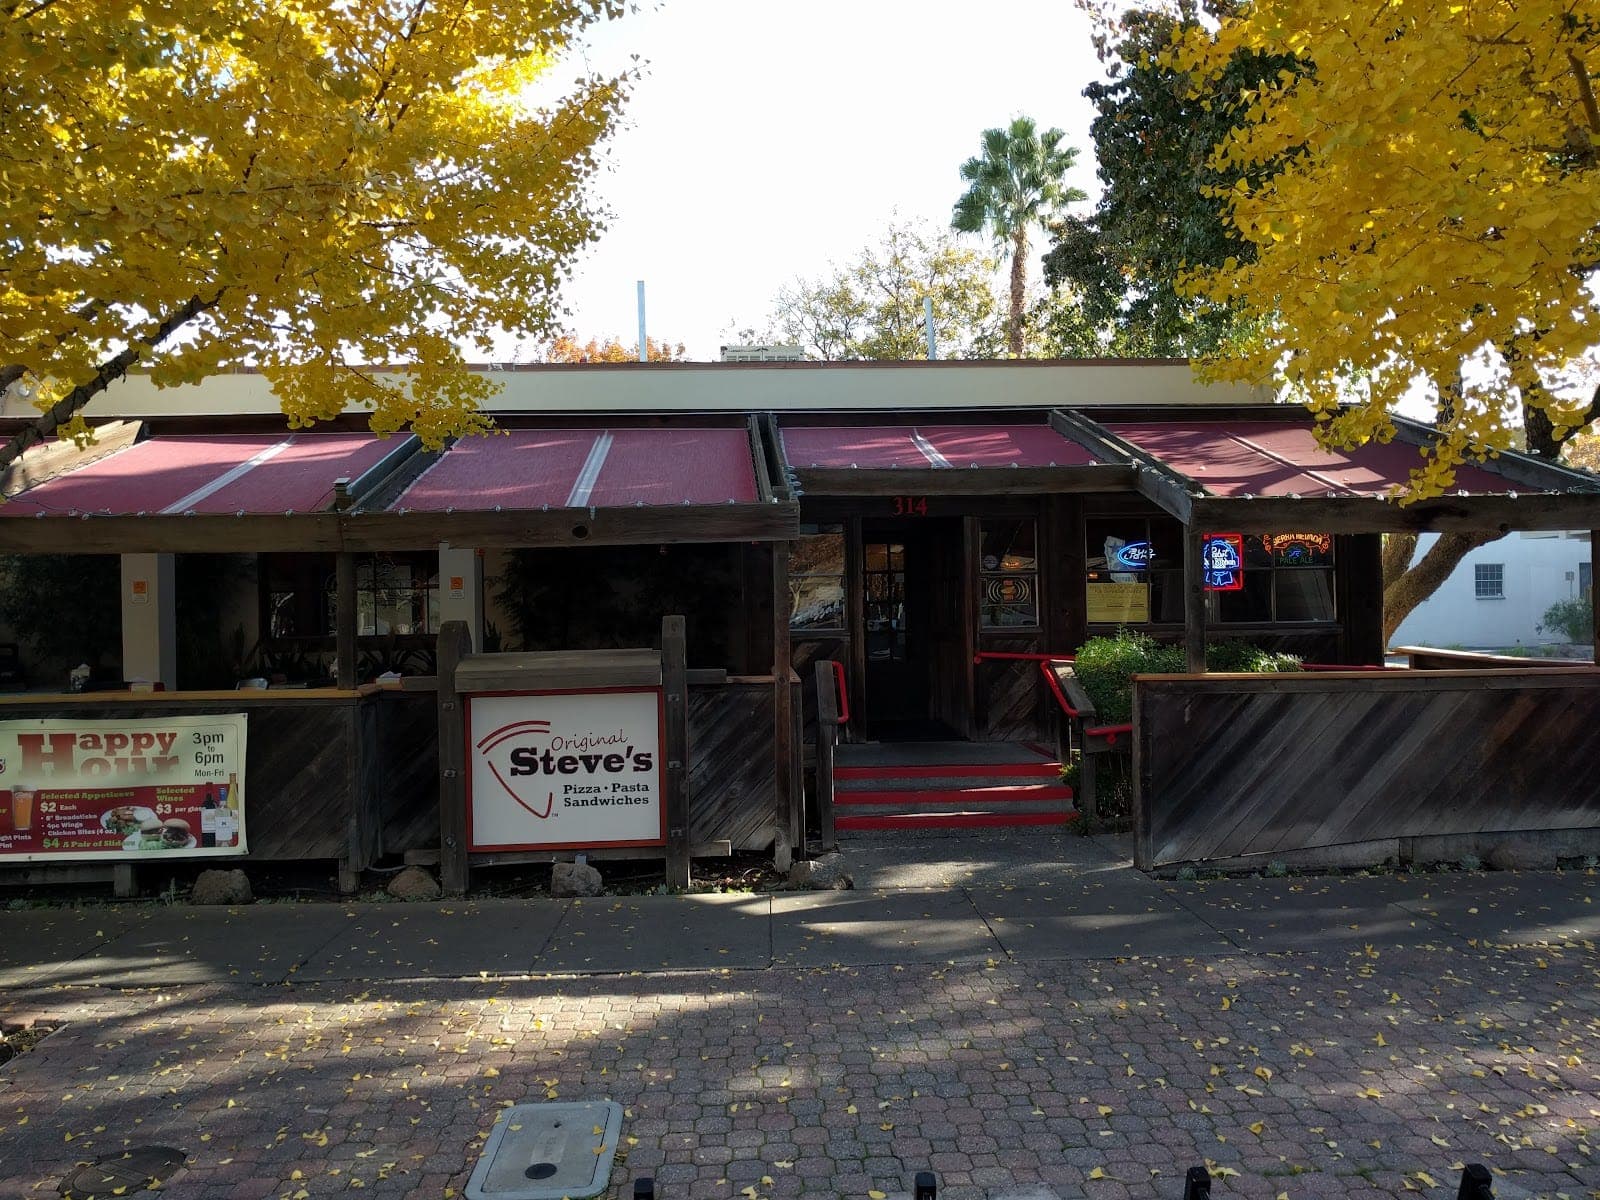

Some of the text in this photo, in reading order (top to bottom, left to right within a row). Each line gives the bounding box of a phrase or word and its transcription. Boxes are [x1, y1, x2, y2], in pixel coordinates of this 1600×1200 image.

[892, 496, 928, 516] 314
[192, 732, 224, 746] 3pm
[551, 728, 629, 752] Original
[17, 732, 178, 778] Happy
[194, 751, 224, 766] 6pm
[510, 745, 653, 777] Steve's
[194, 768, 225, 777] Mon-Fri
[563, 782, 650, 795] Pizza Pasta
[40, 801, 56, 813] $2
[564, 795, 650, 808] Sandwiches
[155, 803, 172, 815] $3
[43, 838, 59, 849] $4
